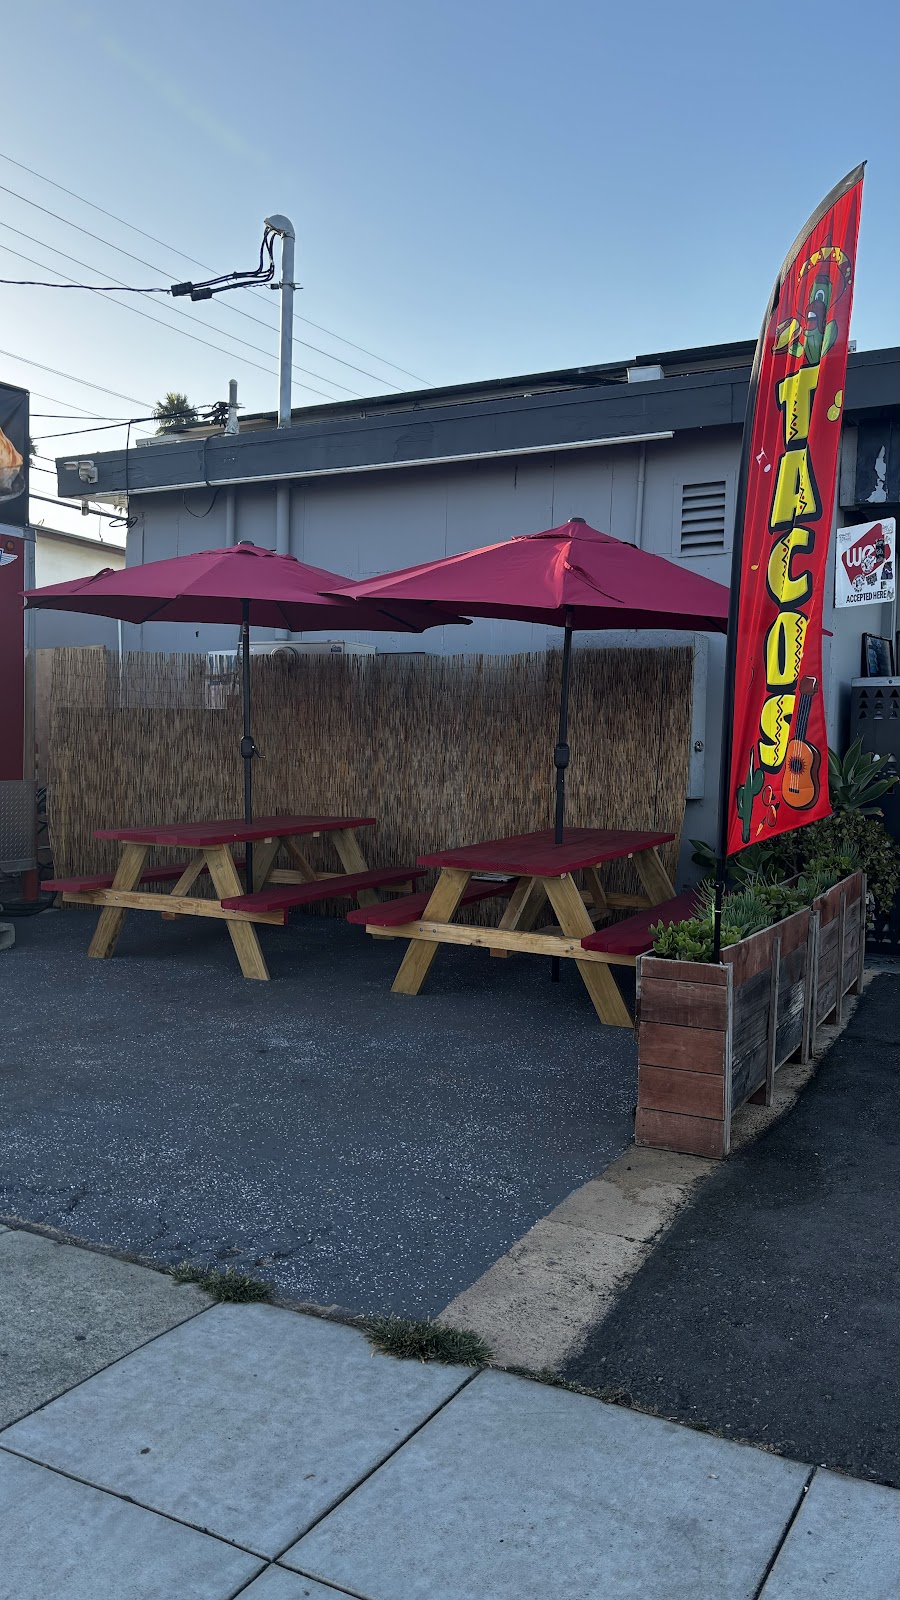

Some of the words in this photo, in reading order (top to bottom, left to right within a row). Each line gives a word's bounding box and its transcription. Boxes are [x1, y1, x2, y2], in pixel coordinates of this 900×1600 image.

[846, 544, 879, 567] we
[758, 363, 821, 772] TACOS
[846, 592, 873, 603] ACCEPTED
[873, 590, 887, 600] HERE
